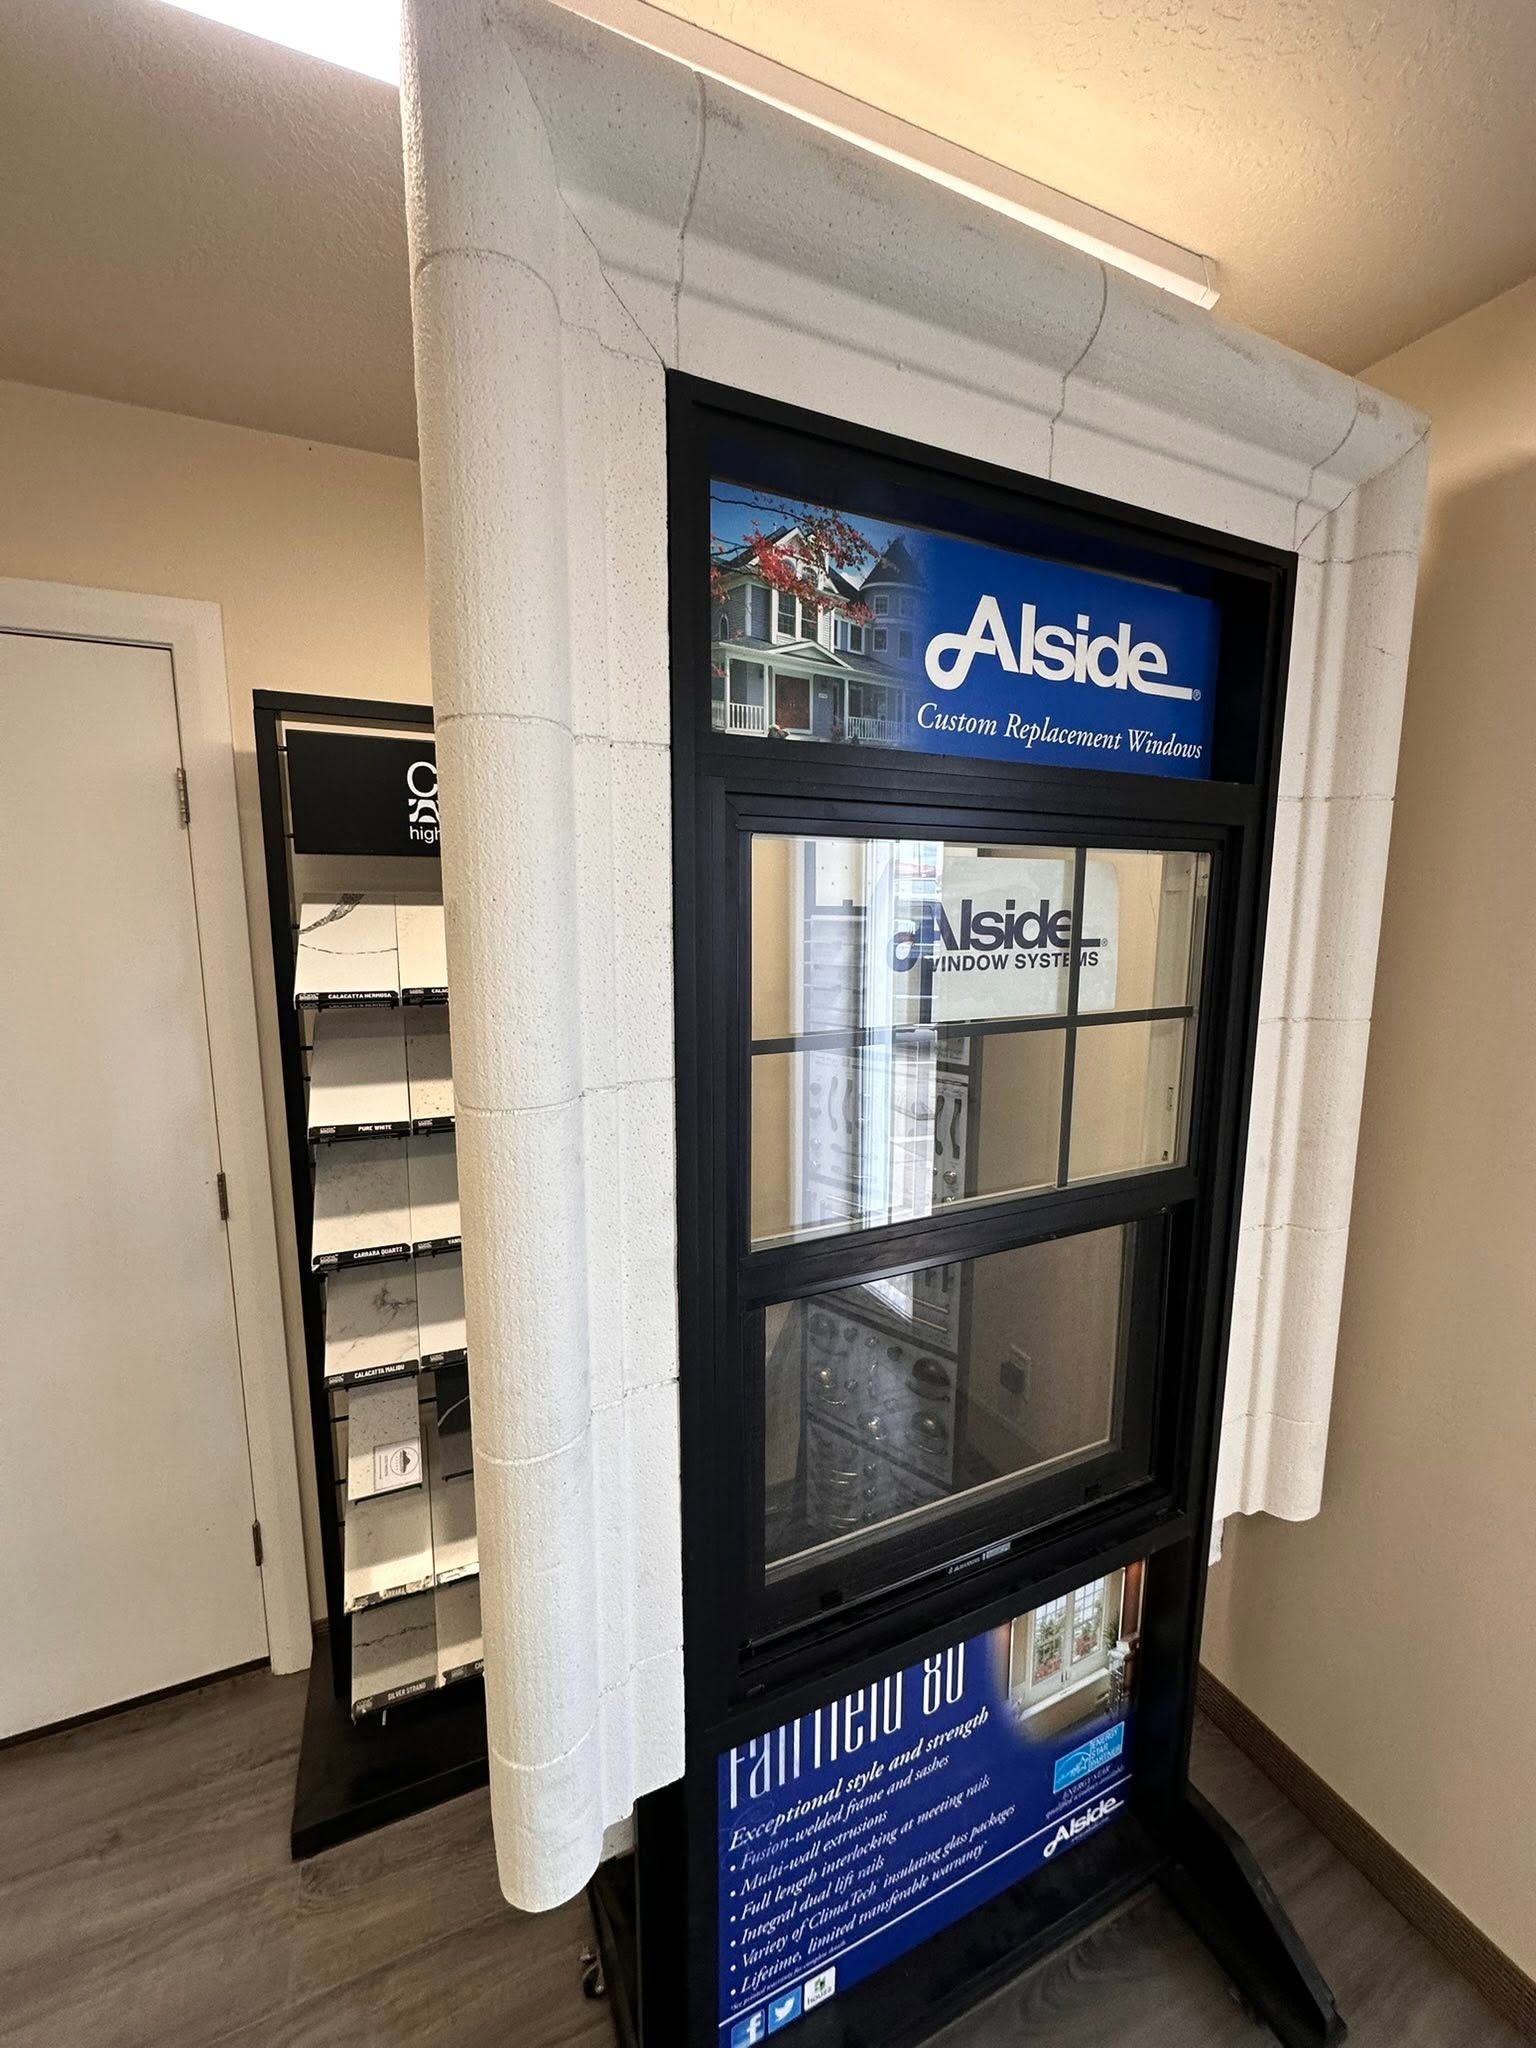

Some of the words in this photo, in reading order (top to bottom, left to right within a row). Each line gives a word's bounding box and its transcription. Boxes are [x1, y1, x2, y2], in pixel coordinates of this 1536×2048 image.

[917, 702, 997, 736] Custom
[1003, 713, 1122, 749] Replacement
[1127, 728, 1203, 759] Windows
[381, 1246, 403, 1255] QUARTZ
[354, 1367, 385, 1379] CALACATTA
[406, 1682, 427, 1693] STRAND
[728, 1777, 843, 1852] Exceptional
[845, 1760, 885, 1793] style
[888, 1737, 924, 1771] and
[926, 1705, 989, 1753] strength
[740, 1804, 844, 1870] Fusion-welded
[843, 1789, 884, 1822] frame
[886, 1768, 914, 1796] and
[914, 1755, 950, 1781] sashes
[739, 1840, 821, 1897] Multi-wall
[823, 1810, 889, 1852] extrusions
[741, 1890, 772, 1920] Full
[774, 1868, 818, 1902] length
[821, 1827, 899, 1878] interlocking
[900, 1818, 914, 1835] at
[917, 1791, 964, 1826] meeting
[966, 1773, 991, 1799] rails
[1043, 1796, 1125, 1857] Alside
[740, 1901, 797, 1945] Integral
[799, 1881, 832, 1912] dual
[834, 1869, 854, 1894] lift
[857, 1854, 885, 1880] rails
[742, 1934, 788, 1967] Variety
[792, 1918, 809, 1943] of
[883, 1845, 942, 1889] insulating
[942, 1832, 968, 1859] glass
[969, 1804, 1016, 1843] packages
[740, 1952, 802, 1994] Lifetime,
[807, 1914, 857, 1955] limited
[859, 1874, 930, 1925] transferable
